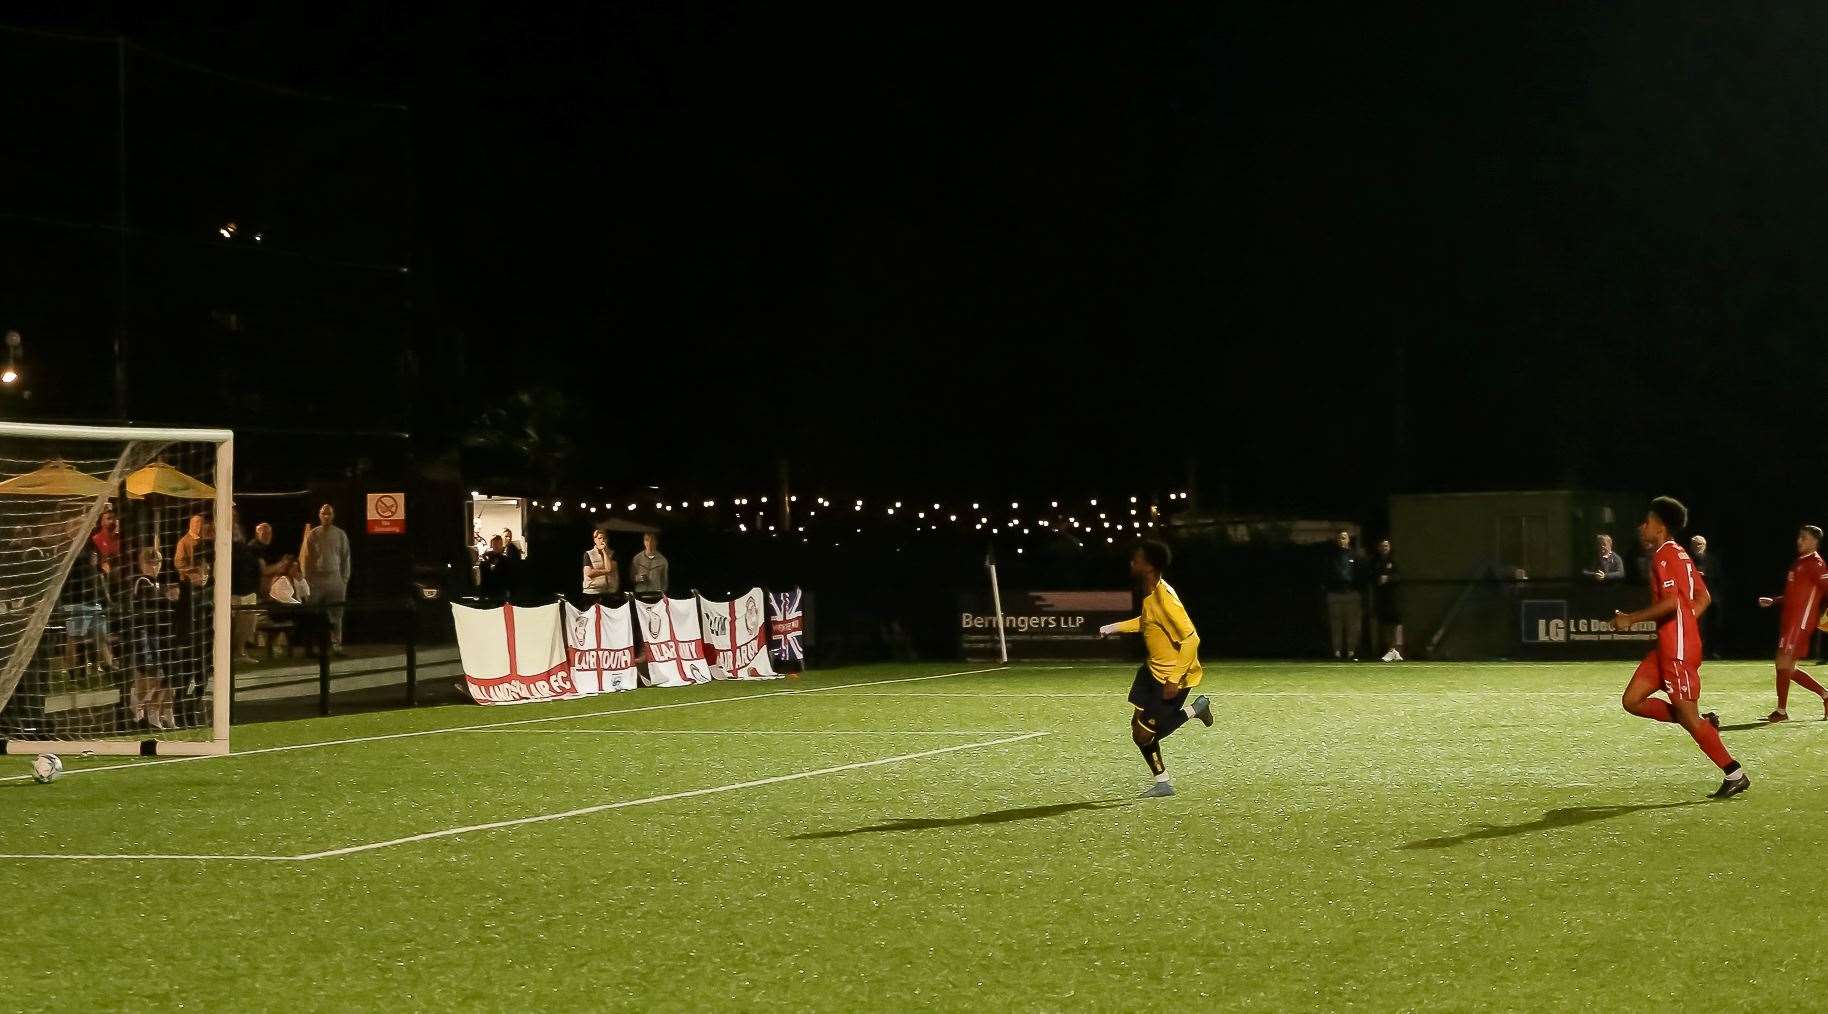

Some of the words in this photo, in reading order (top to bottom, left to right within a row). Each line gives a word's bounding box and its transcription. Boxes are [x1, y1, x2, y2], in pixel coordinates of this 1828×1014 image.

[962, 613, 1056, 631] Berrngers
[1061, 616, 1085, 628] LLP
[1538, 618, 1565, 641] LG
